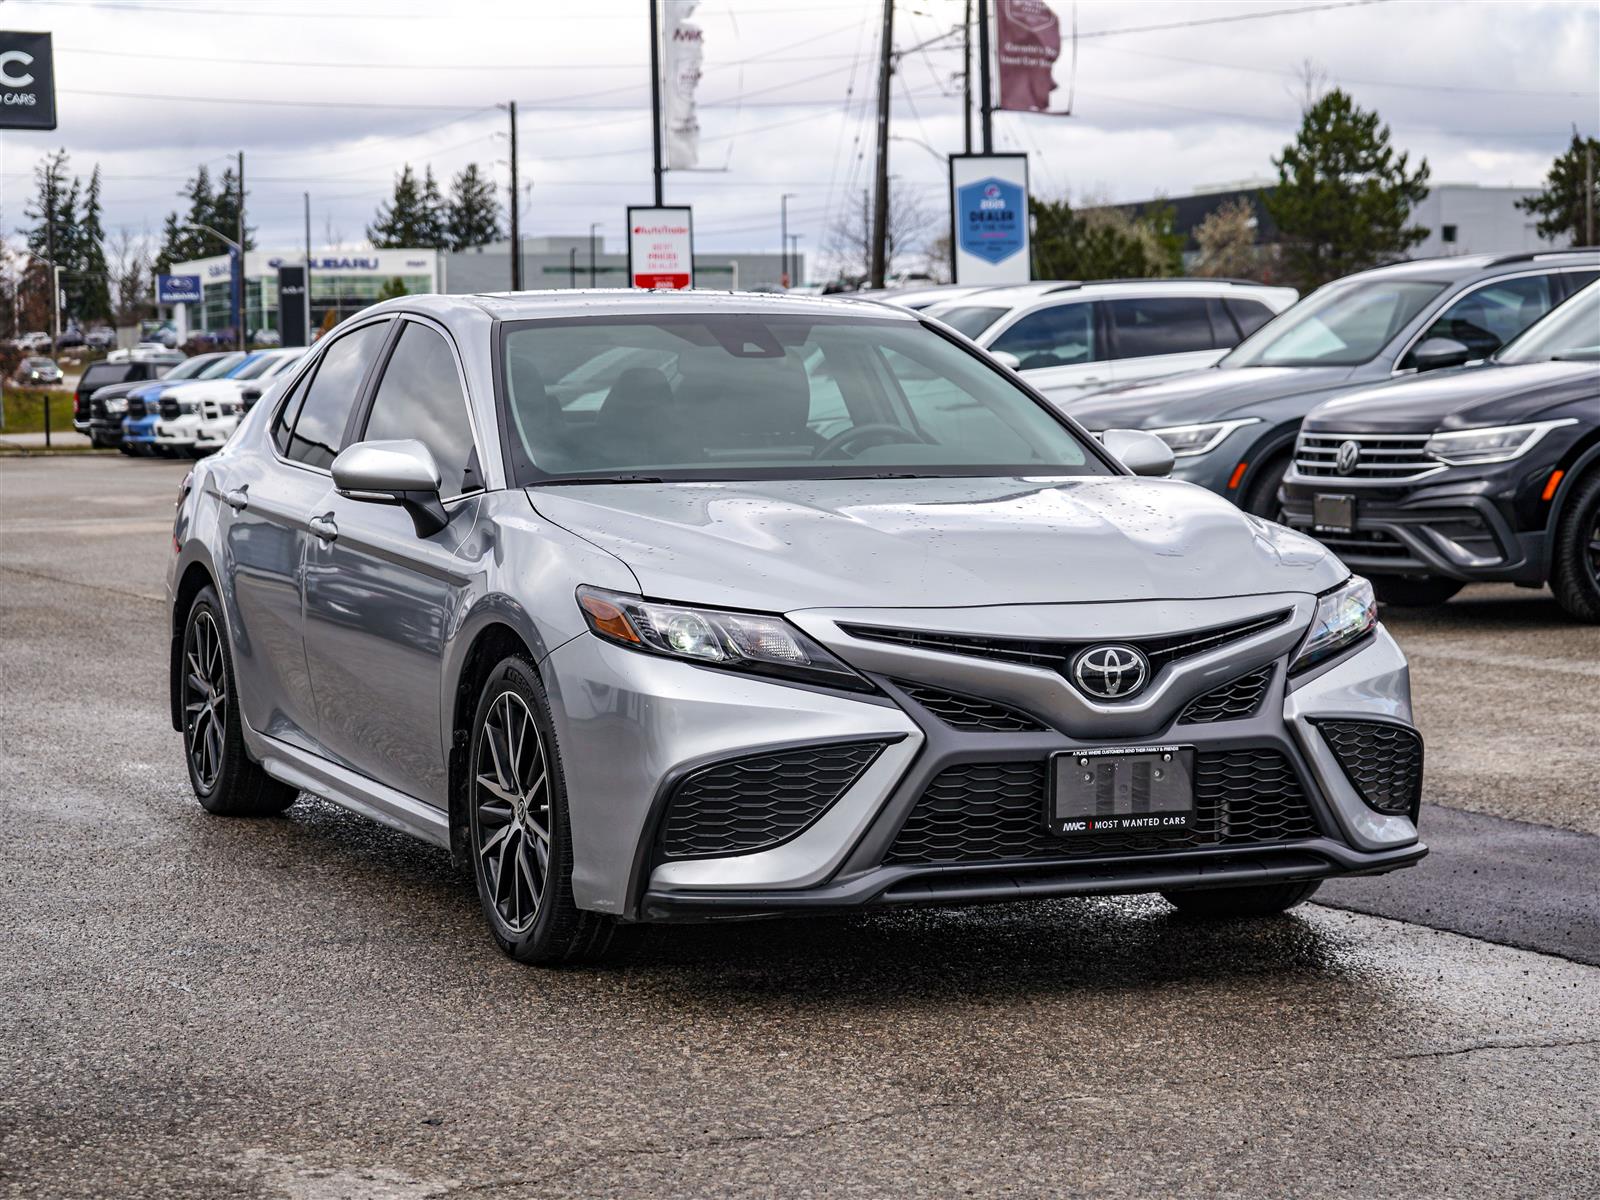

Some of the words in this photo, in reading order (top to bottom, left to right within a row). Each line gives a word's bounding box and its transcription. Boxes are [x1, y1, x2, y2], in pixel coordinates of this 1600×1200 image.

[4, 93, 36, 106] CARS
[969, 211, 1015, 223] DEALER
[1094, 820, 1119, 829] MOST
[1122, 818, 1160, 827] WANTED
[1163, 816, 1186, 825] CARS
